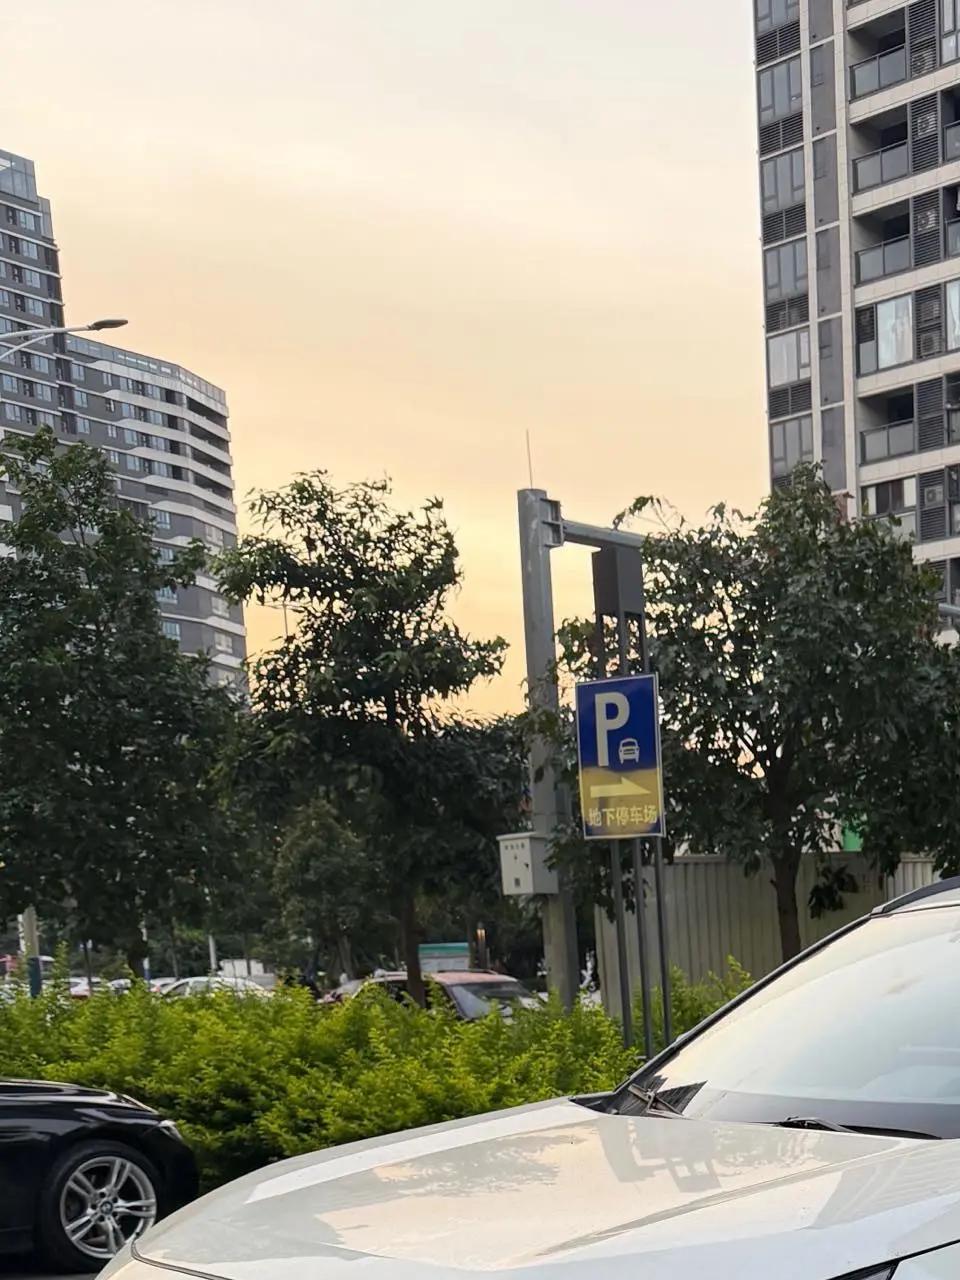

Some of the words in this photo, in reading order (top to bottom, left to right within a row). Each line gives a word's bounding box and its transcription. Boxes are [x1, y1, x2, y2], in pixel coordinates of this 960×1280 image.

[595, 691, 630, 767] P
[588, 805, 658, 827] 地下停车场
